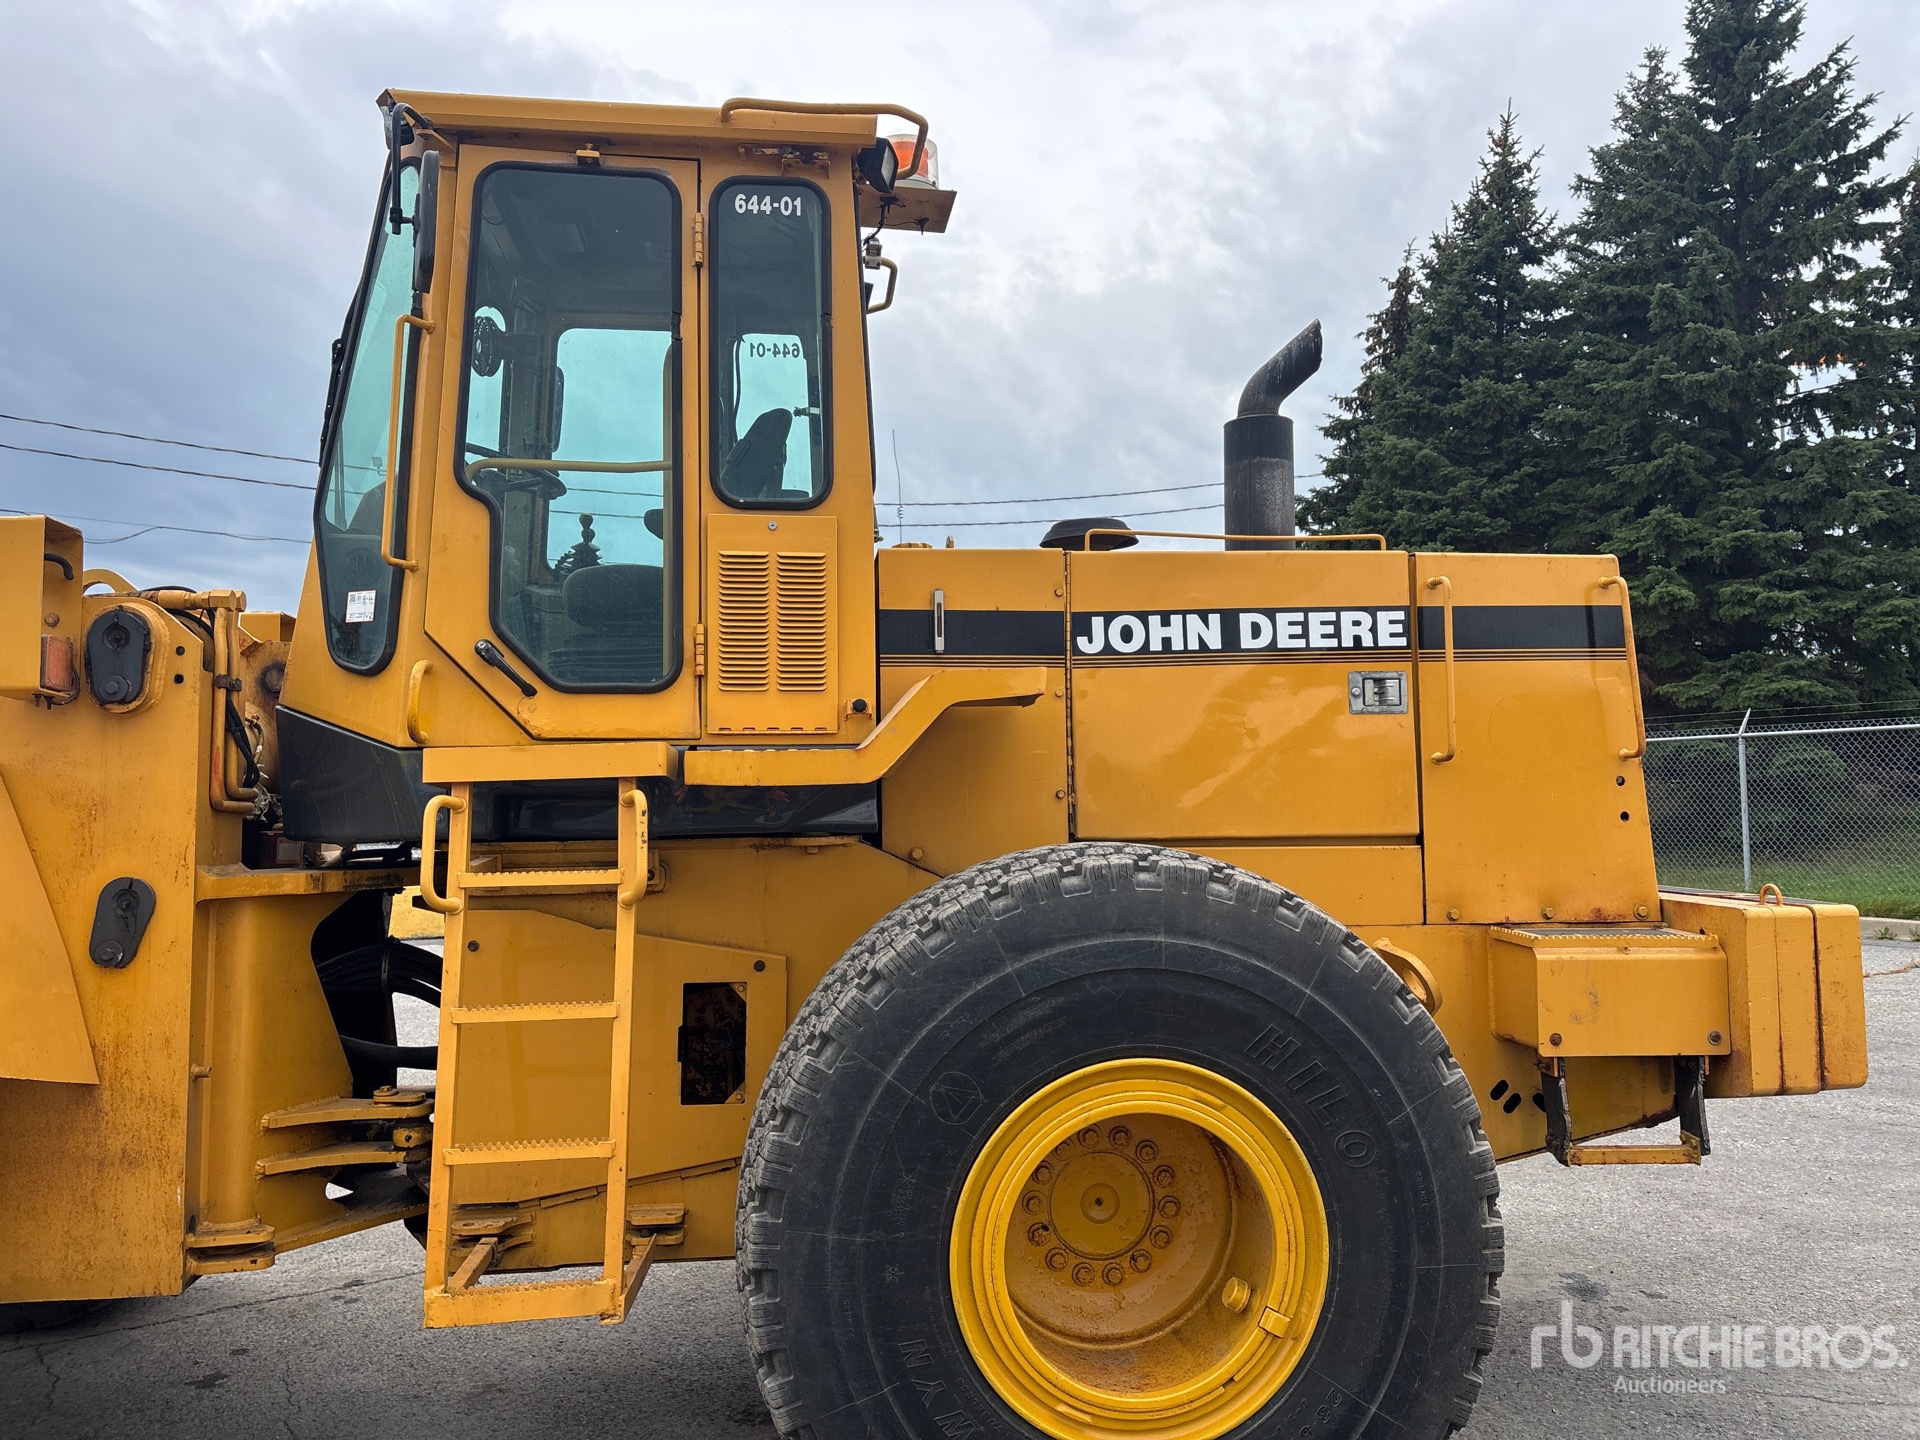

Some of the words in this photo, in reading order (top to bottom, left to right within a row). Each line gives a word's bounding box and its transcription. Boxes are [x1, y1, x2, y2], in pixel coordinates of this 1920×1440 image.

[734, 193, 802, 216] 644-01
[1076, 613, 1222, 654] JOHN
[1239, 611, 1408, 650] DEERE
[1243, 1023, 1378, 1168] HILO
